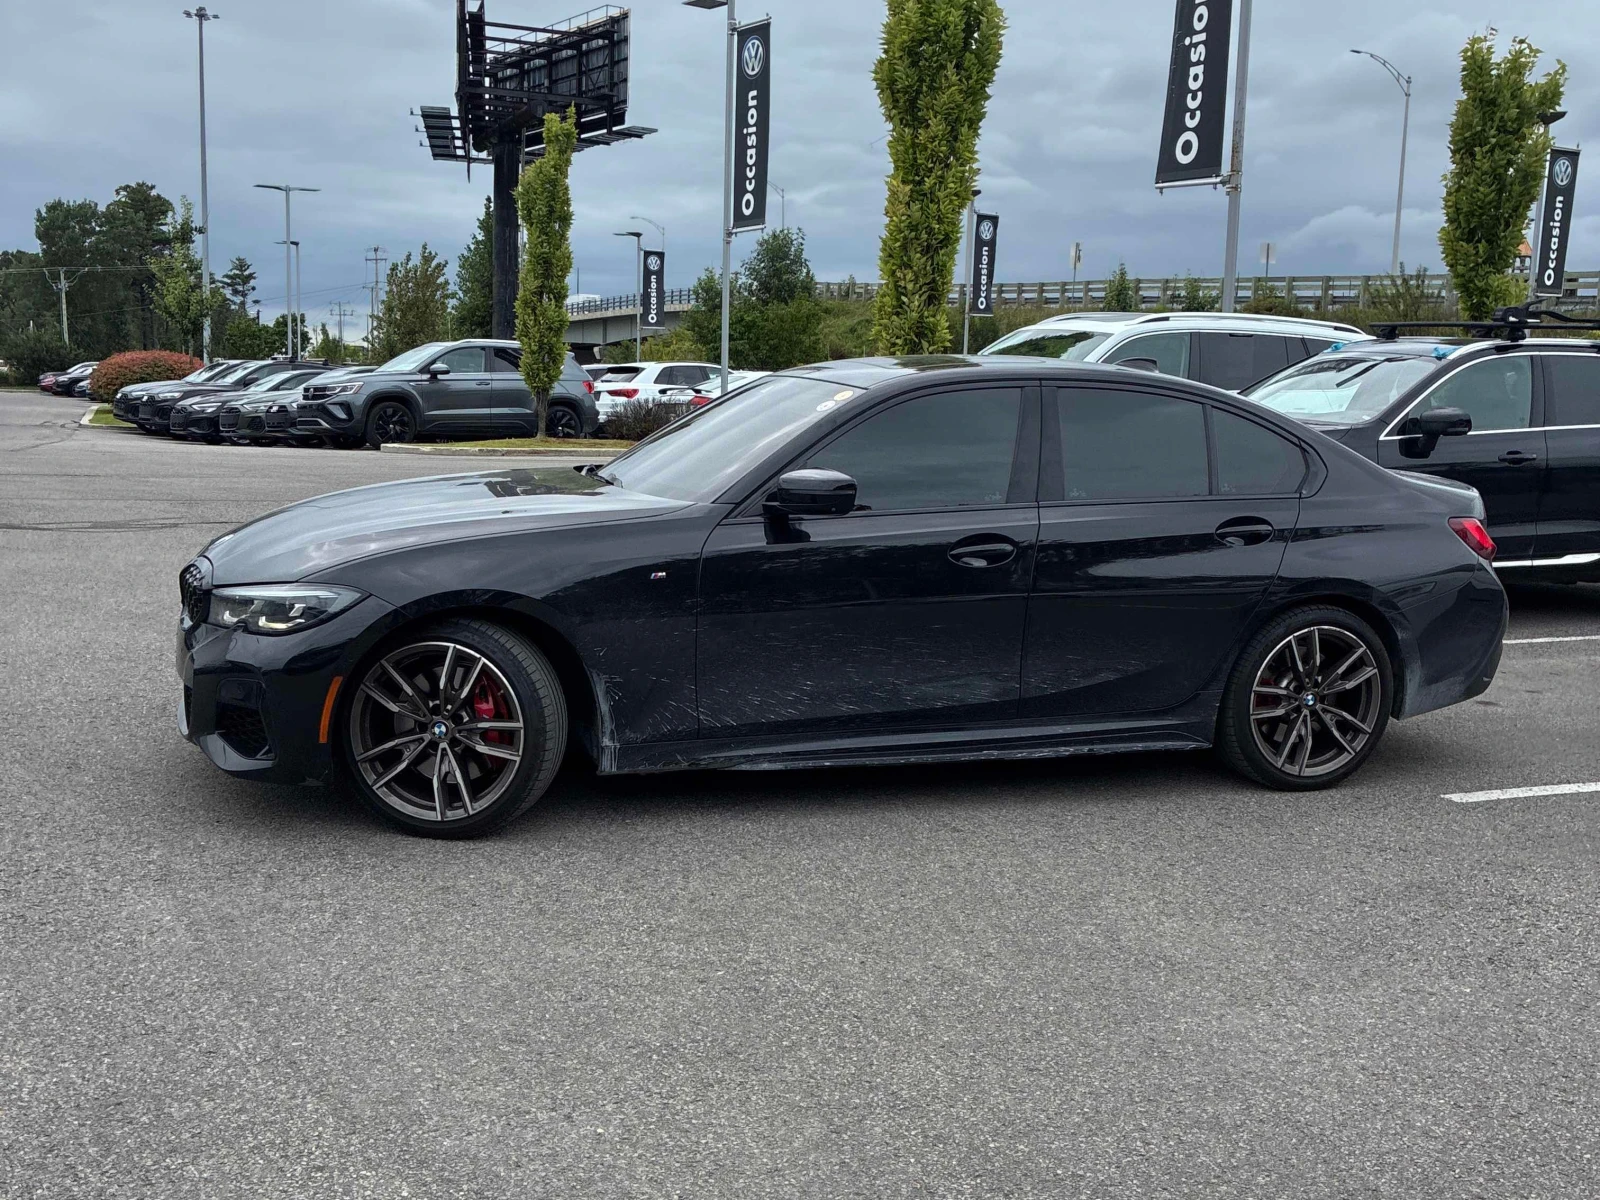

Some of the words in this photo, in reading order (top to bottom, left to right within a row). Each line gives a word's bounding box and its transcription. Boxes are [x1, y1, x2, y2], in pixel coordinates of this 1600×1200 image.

[1175, 0, 1209, 165] Occasio
[741, 89, 758, 216] Occasion
[977, 246, 989, 310] Occasion
[1544, 195, 1564, 286] Occasion
[648, 275, 657, 323] Occasion
